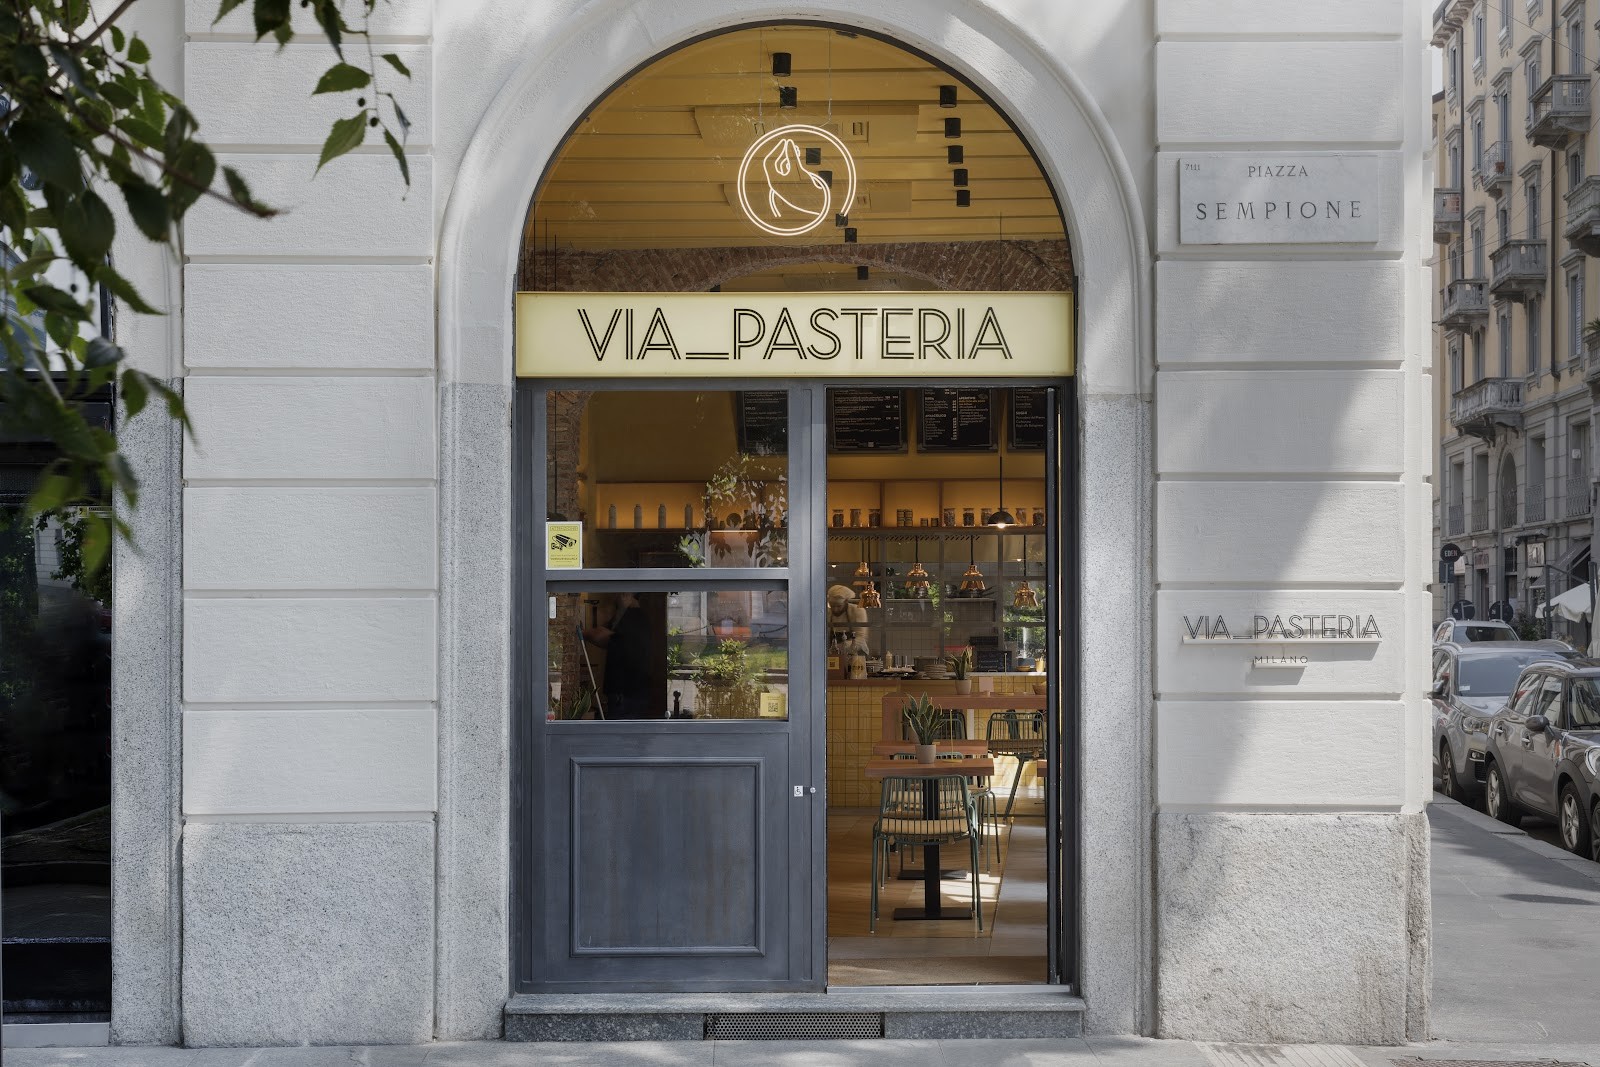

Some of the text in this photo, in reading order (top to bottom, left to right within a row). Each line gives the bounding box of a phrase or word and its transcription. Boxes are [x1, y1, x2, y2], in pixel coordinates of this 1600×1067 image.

[1248, 165, 1308, 178] PIAZZA
[1195, 201, 1362, 221] SEMPIONE
[1253, 655, 1309, 665] MILANO
